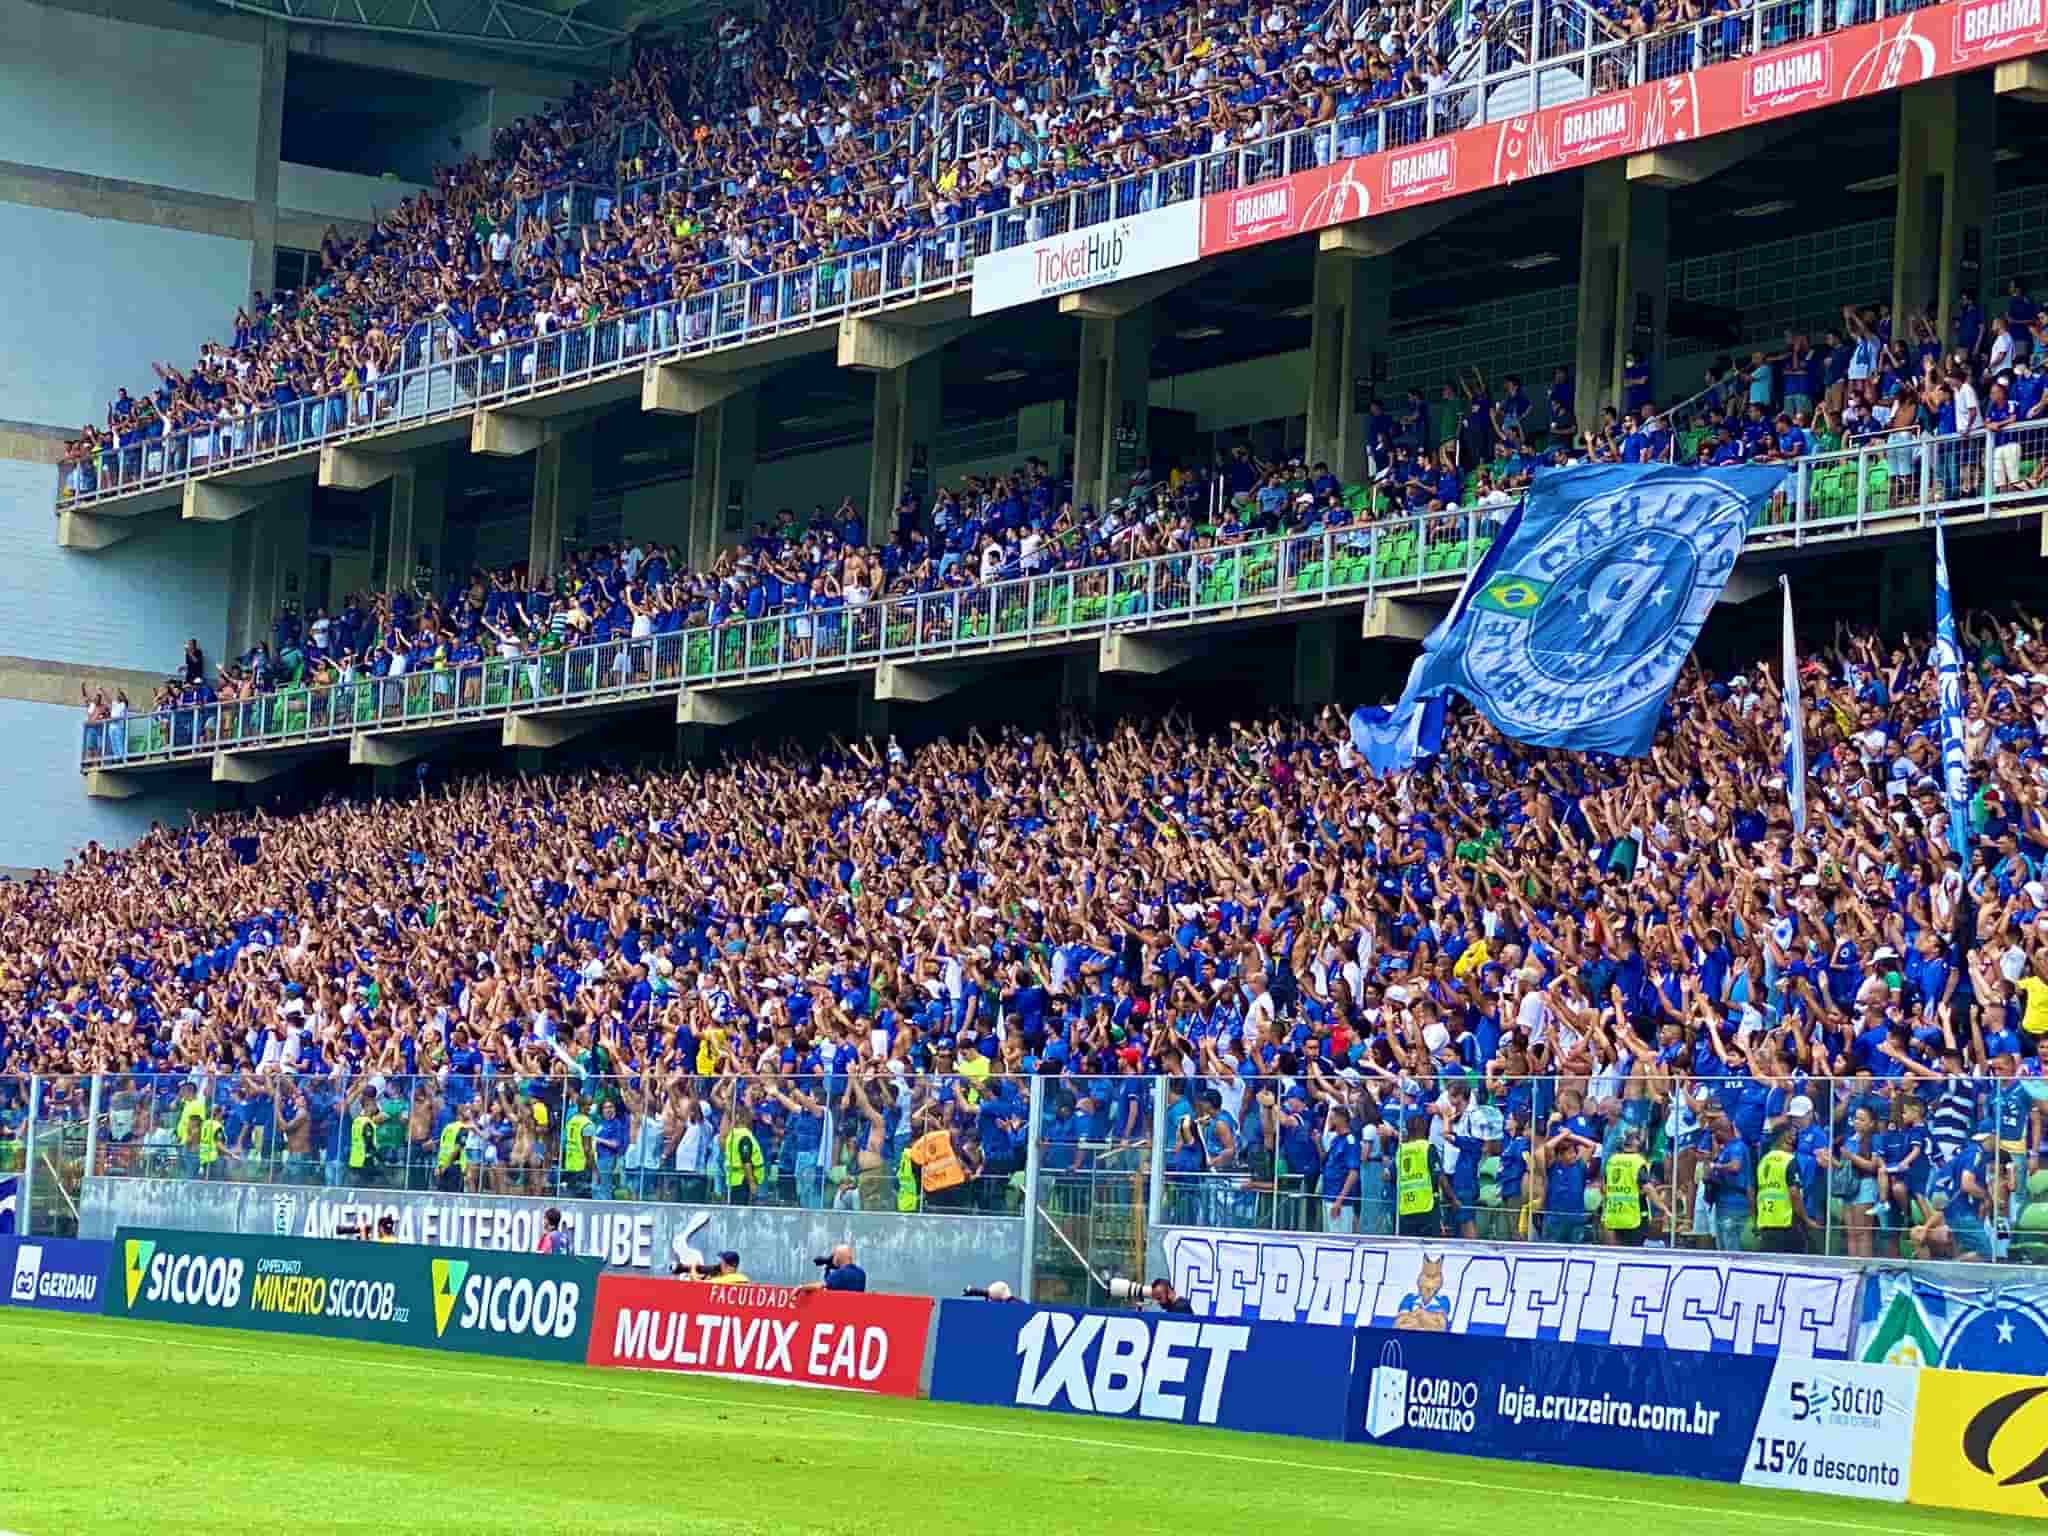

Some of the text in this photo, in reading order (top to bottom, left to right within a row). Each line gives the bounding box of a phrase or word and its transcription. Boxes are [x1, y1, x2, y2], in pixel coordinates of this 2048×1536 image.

[1965, 0, 2041, 42] BRAHMA
[1752, 49, 1822, 97] BRAHMA
[1563, 102, 1626, 145] BRAHMA
[1391, 148, 1448, 188] BRAHMA
[1236, 189, 1287, 226] BRAHMA
[1034, 227, 1122, 288] TicketHub
[38, 1271, 97, 1299] GERDAU
[147, 1252, 244, 1308] SICOOB
[251, 1274, 326, 1316] MINEIRO
[326, 1278, 395, 1321] SICOOB
[709, 1285, 800, 1309] FACULDADE
[460, 1274, 579, 1338] SICOOB
[613, 1307, 888, 1381] MULTIVIX EAD
[1016, 1311, 1251, 1424] 1XBET
[1407, 1405, 1475, 1432] CRUZEIRO
[1497, 1383, 1721, 1435] loja.cruzeiro.com.br
[1831, 1381, 1883, 1415] SÓCIO
[1754, 1437, 1899, 1486] 15% desconto
